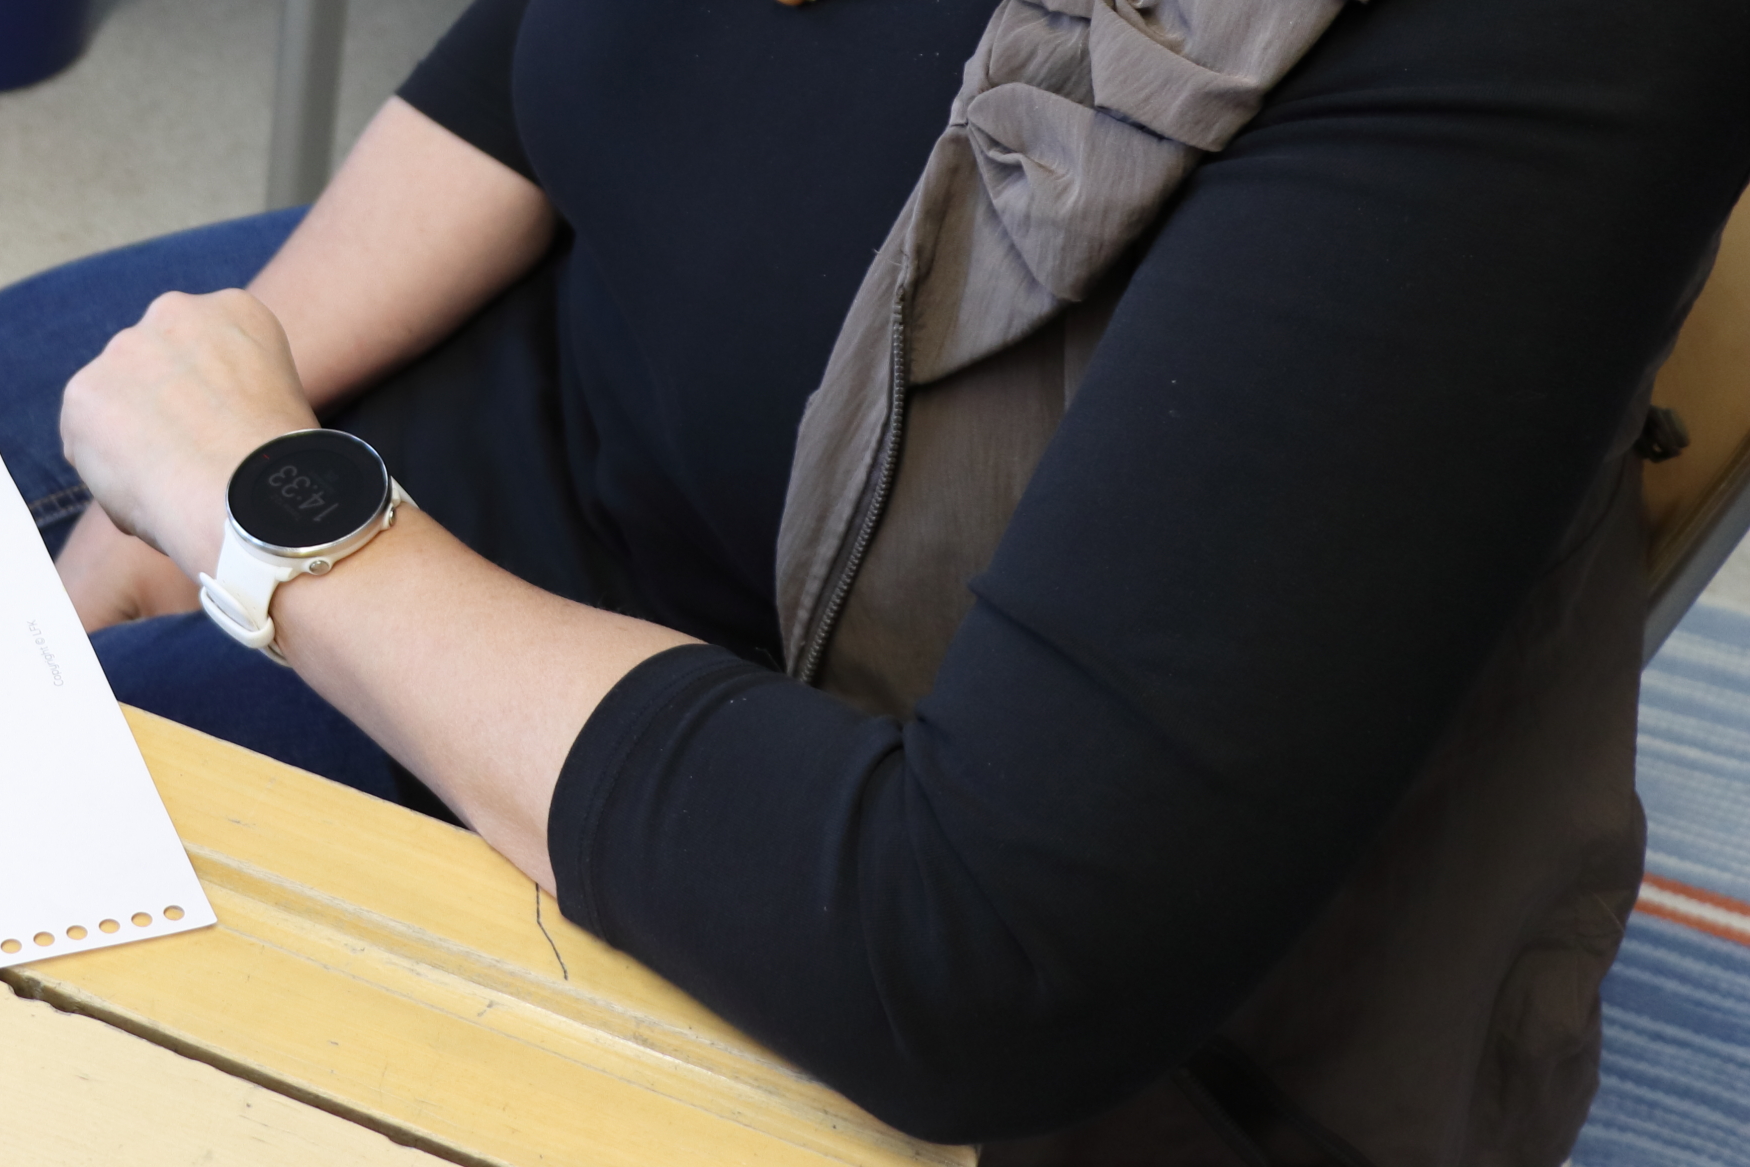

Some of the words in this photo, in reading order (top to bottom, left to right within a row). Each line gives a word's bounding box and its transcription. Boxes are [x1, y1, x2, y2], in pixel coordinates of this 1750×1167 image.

[268, 465, 339, 522] 14:33
[27, 619, 42, 637] LFK
[40, 646, 64, 687] Copyright
